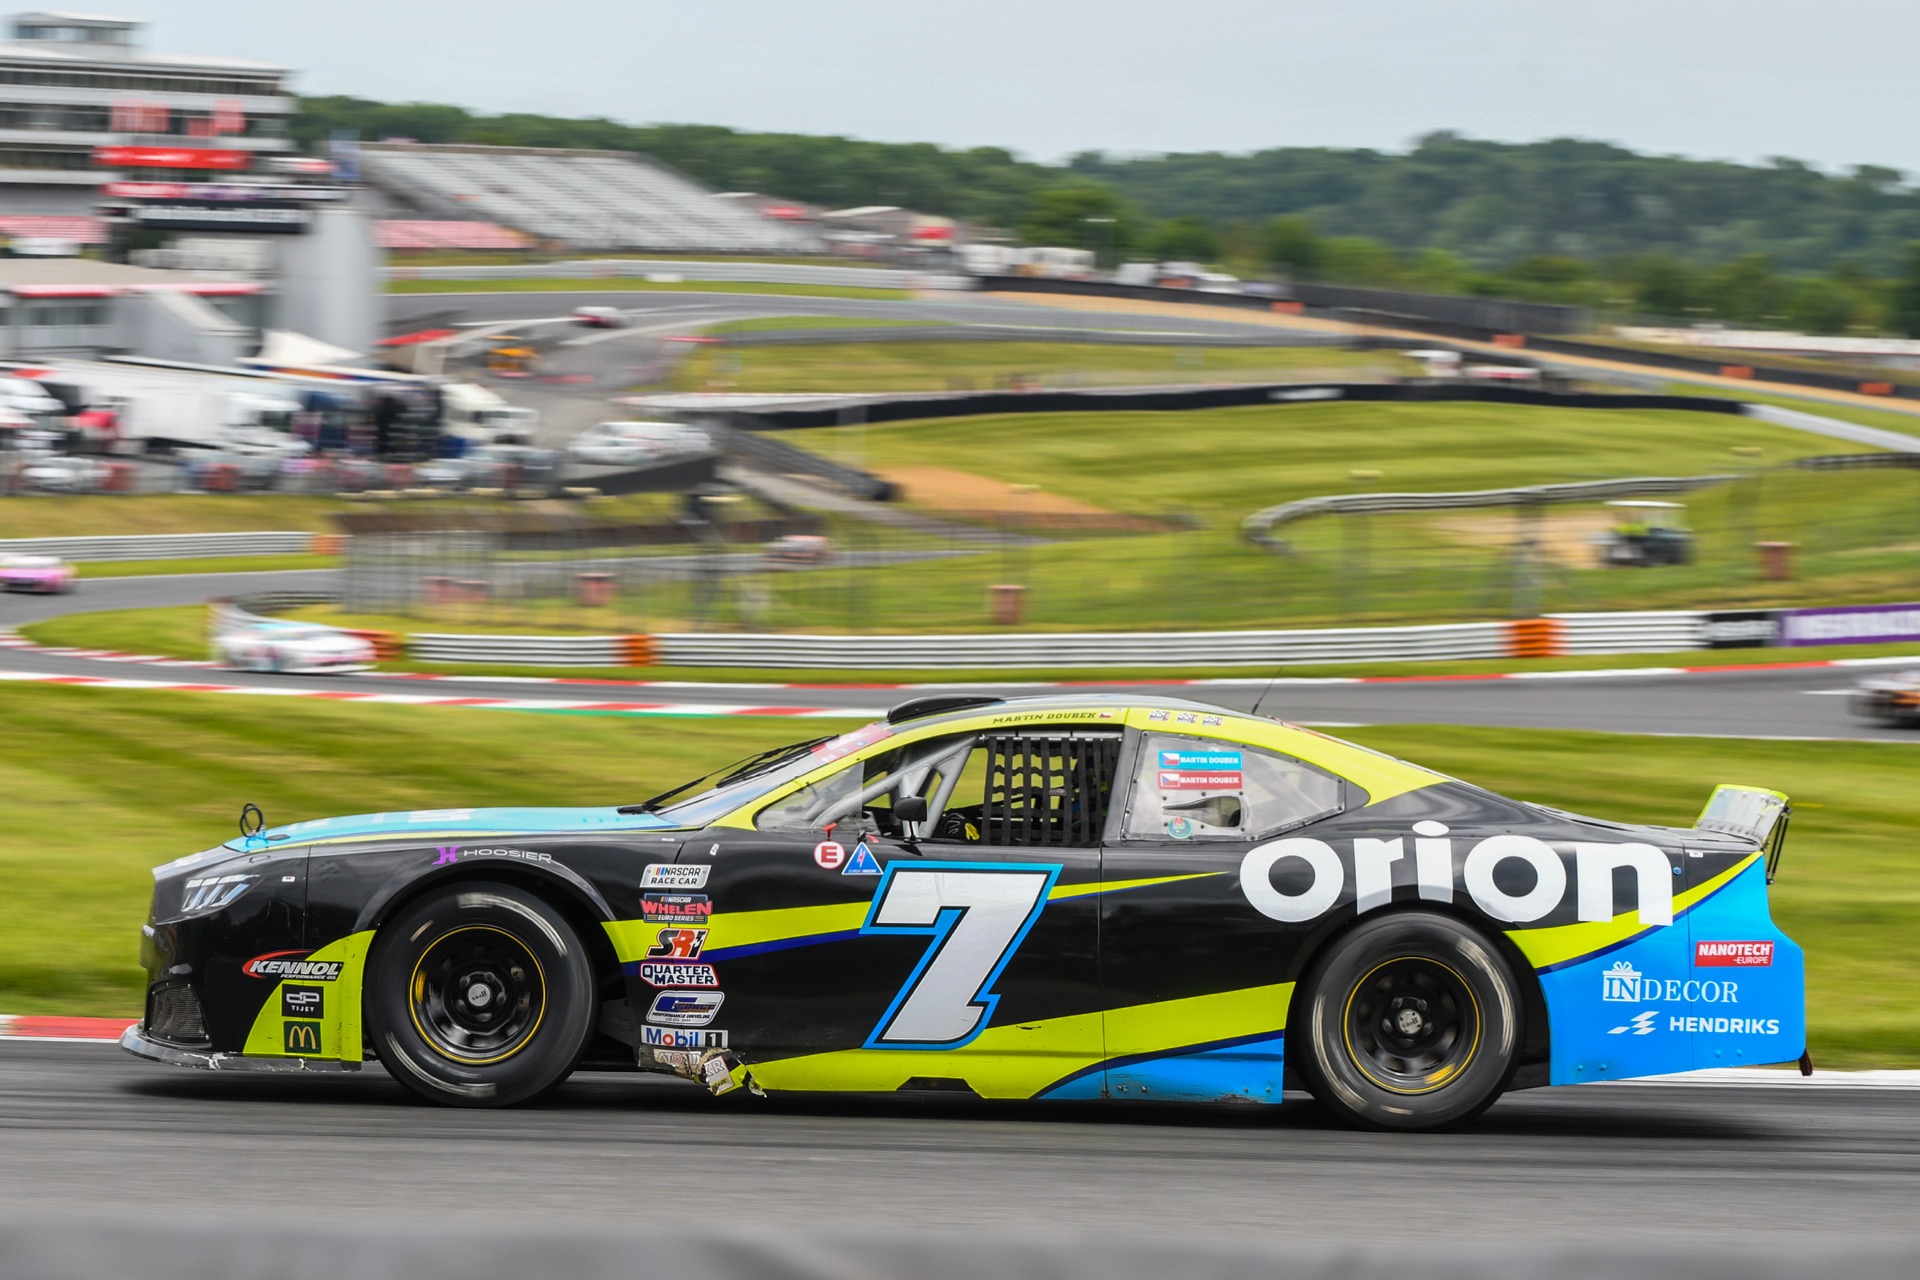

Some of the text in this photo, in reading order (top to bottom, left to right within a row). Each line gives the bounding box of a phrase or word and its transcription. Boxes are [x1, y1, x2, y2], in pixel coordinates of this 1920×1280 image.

[993, 712, 1097, 724] MARTIN DOUBEK
[464, 848, 552, 864] HOOSIER
[821, 845, 838, 863] E
[664, 867, 701, 876] NASCAR
[1239, 820, 1673, 926] orion
[651, 877, 676, 885] RACE
[641, 900, 713, 916] WHELEN
[866, 865, 1055, 1045] 7
[1699, 943, 1771, 956] NANOTECH
[249, 960, 339, 976] KENNOL
[642, 965, 711, 979] QUARTER
[654, 974, 714, 985] MASTER
[1670, 1016, 1780, 1035] HENDRIKS
[646, 1027, 717, 1047] Mobil 1
